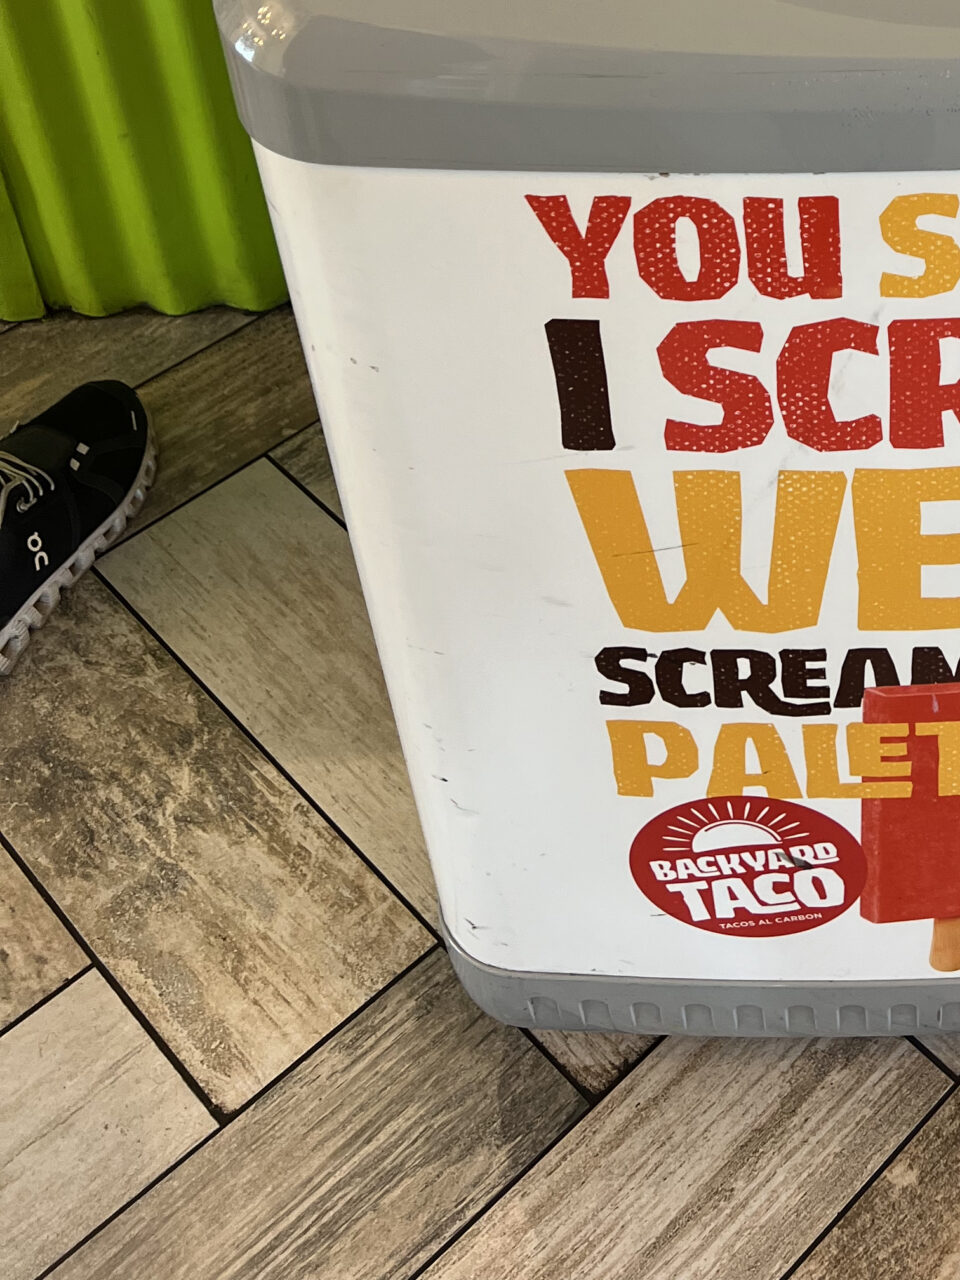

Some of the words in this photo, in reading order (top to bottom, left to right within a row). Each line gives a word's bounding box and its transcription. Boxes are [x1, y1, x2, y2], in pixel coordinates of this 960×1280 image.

[525, 193, 842, 301] YOU
[544, 319, 616, 451] I
[649, 842, 840, 881] BACKYARD
[666, 867, 844, 922] TACO
[720, 920, 755, 930] TACOS
[756, 918, 772, 927] AL
[774, 913, 823, 924] CARBON
